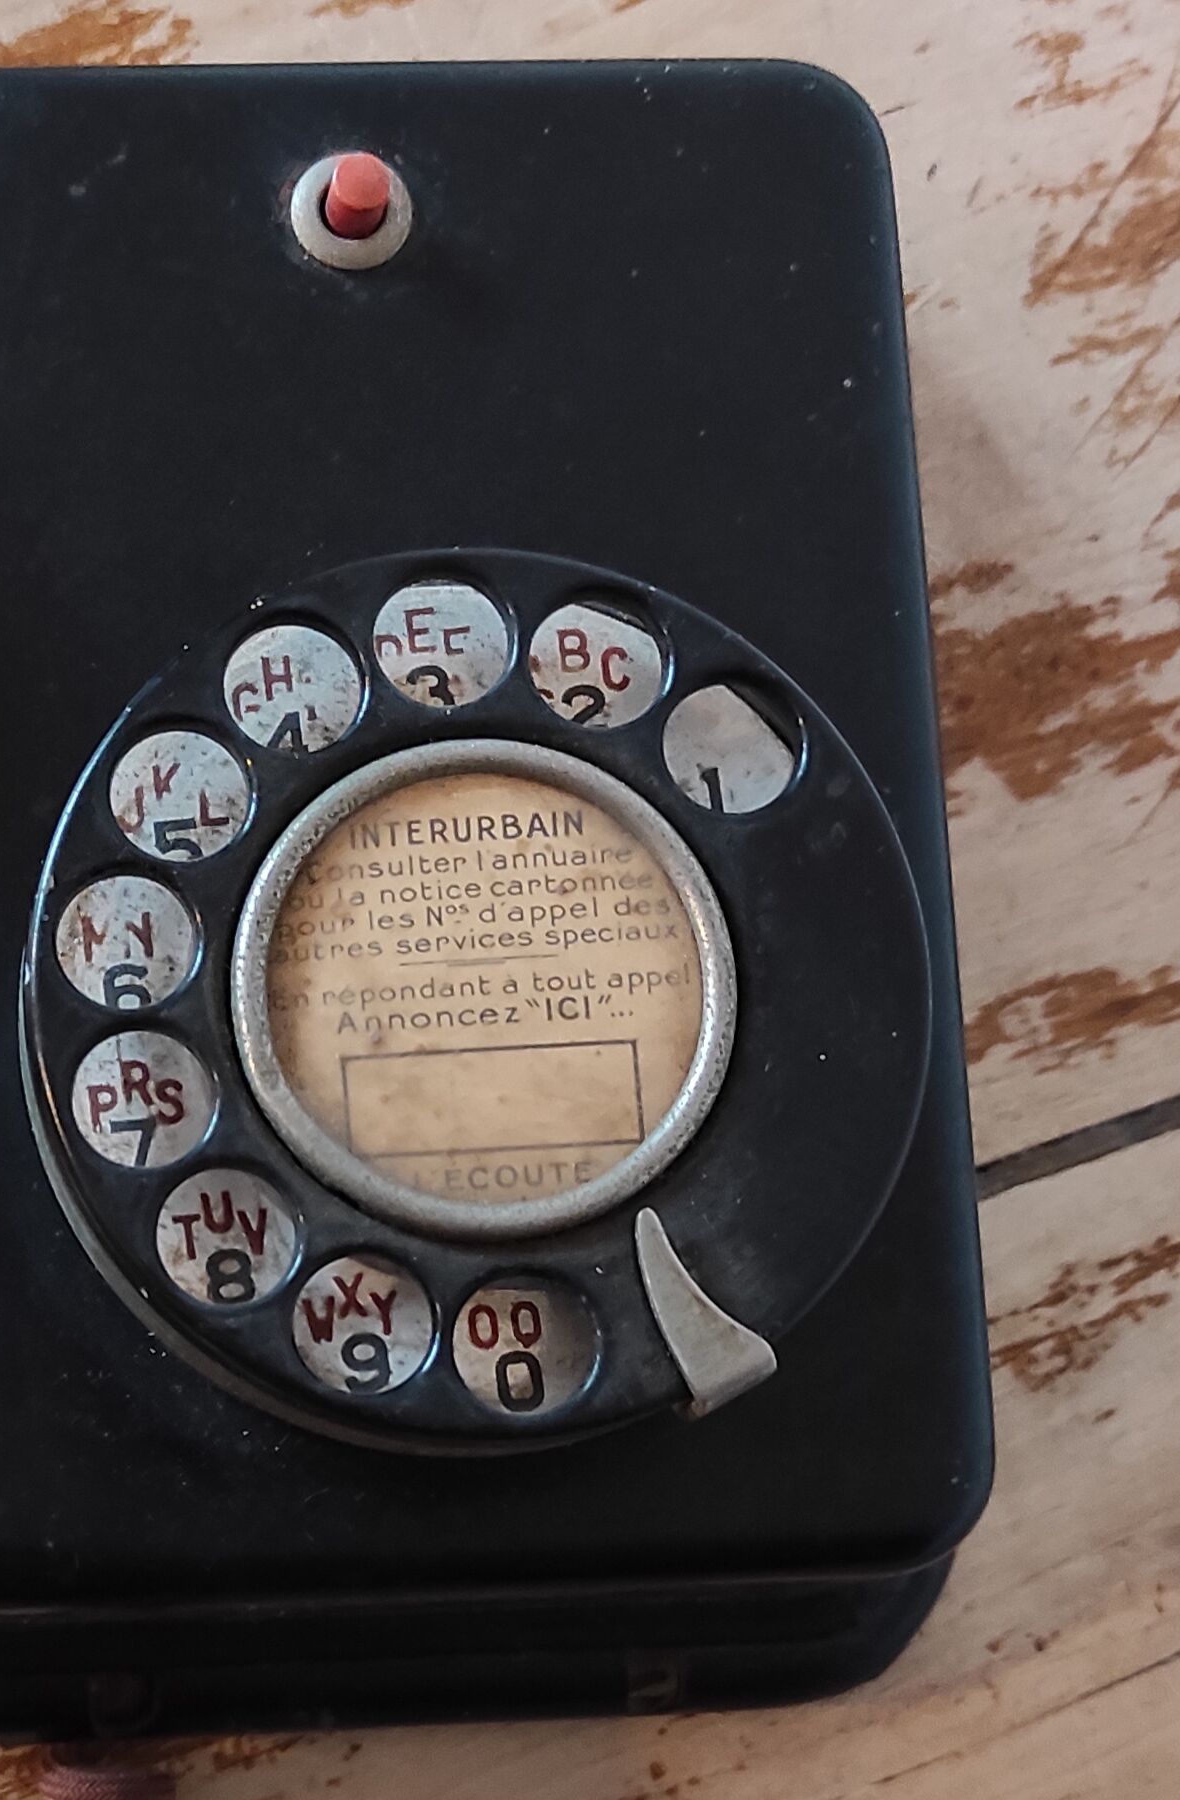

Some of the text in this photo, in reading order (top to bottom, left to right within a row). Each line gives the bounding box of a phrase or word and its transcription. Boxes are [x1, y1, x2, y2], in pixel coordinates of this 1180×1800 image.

[561, 685, 606, 727] 2
[696, 762, 725, 814] 1
[153, 817, 203, 860] 5
[350, 810, 585, 850] INTERURBAIN
[337, 888, 366, 907] la
[380, 879, 482, 904] notice
[368, 910, 415, 931] les
[478, 896, 598, 928] d'appel
[614, 896, 670, 916] des
[397, 928, 533, 954] services
[103, 963, 152, 1009] 6
[322, 974, 491, 1010] répondant
[533, 968, 597, 993] tout
[608, 962, 691, 995] appel
[337, 1005, 520, 1036] Annoncez
[87, 1060, 185, 1134] PRS
[109, 1116, 157, 1167] 7
[172, 1190, 268, 1261] TUV
[206, 1248, 256, 1304] 8
[301, 1272, 397, 1343] WXY
[341, 1333, 392, 1394] 9
[495, 1351, 545, 1412] 0
